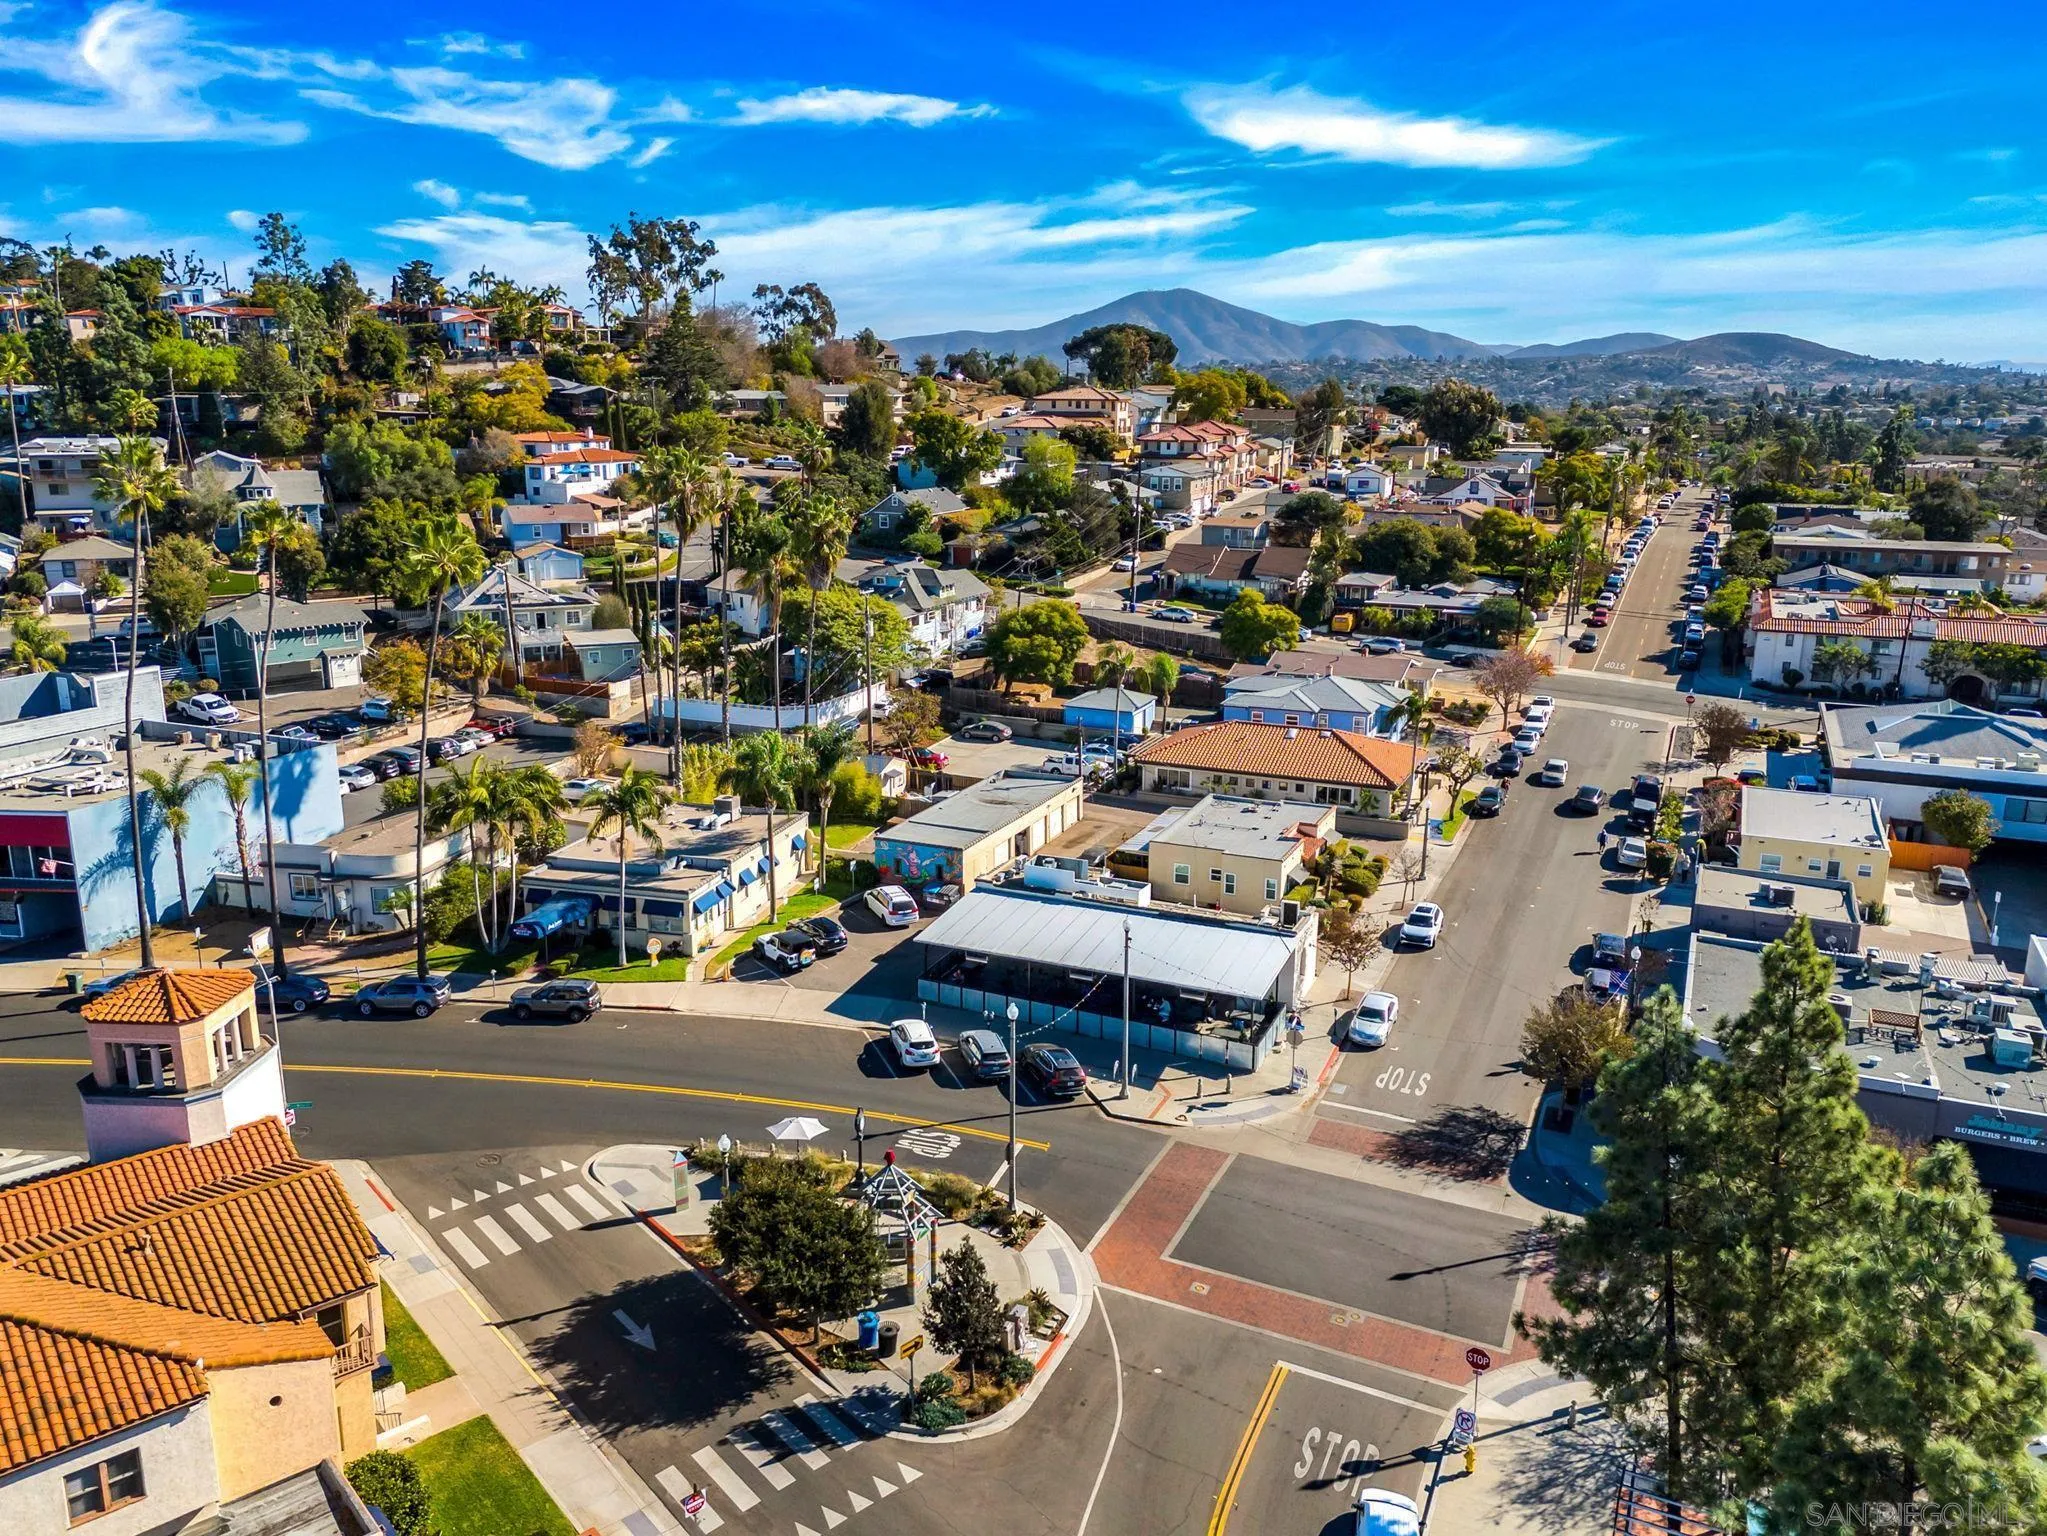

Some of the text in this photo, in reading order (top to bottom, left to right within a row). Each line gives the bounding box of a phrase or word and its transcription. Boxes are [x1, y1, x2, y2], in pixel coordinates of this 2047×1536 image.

[1604, 661, 1626, 671] STOP
[1609, 719, 1639, 730] STOP
[1375, 1064, 1432, 1096] STOP
[1954, 1126, 2039, 1146] BURGERS BREW
[1467, 1352, 1489, 1365] STOP
[1293, 1426, 1380, 1498] STOP
